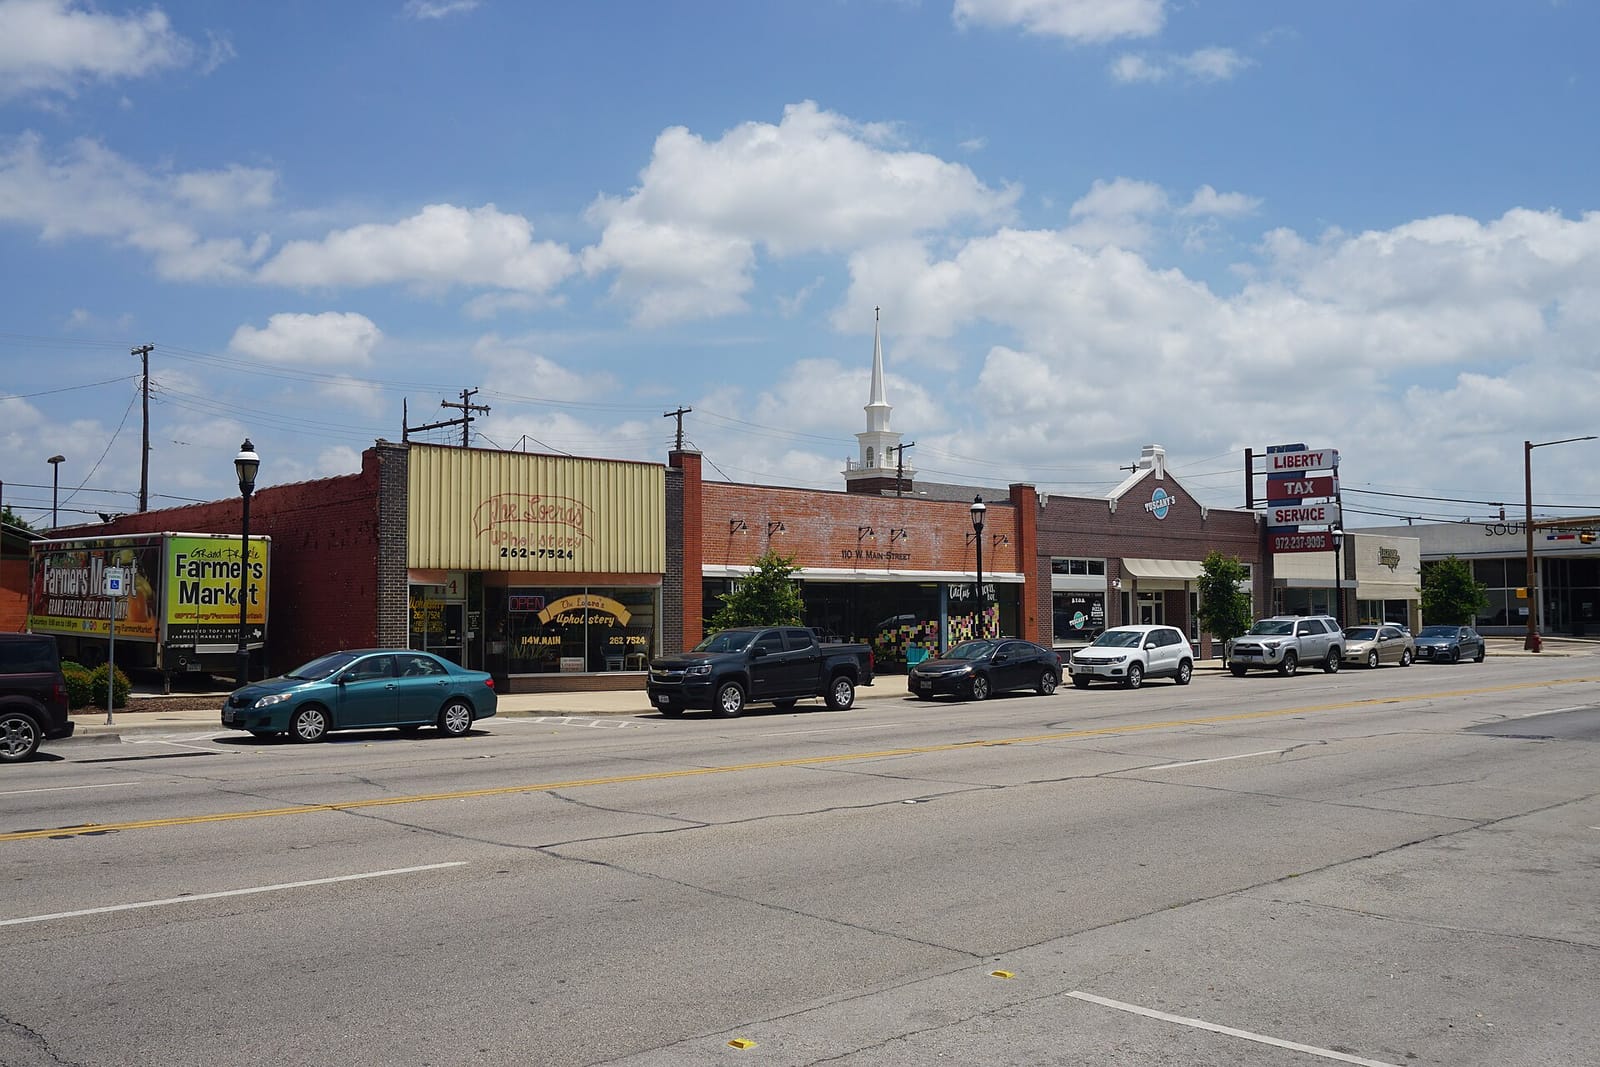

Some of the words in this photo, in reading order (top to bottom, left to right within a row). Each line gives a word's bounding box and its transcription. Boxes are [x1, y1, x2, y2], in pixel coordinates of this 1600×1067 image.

[1274, 452, 1323, 469] LIBERTY
[1283, 481, 1314, 495] TAX
[1275, 507, 1325, 523] SERVICE
[841, 550, 853, 560] 110
[43, 558, 88, 595] Farmers
[90, 556, 137, 596] Maet
[179, 580, 259, 605] Markt
[511, 597, 544, 610] OPEN
[609, 636, 624, 645] 262
[626, 636, 646, 645] 7524
